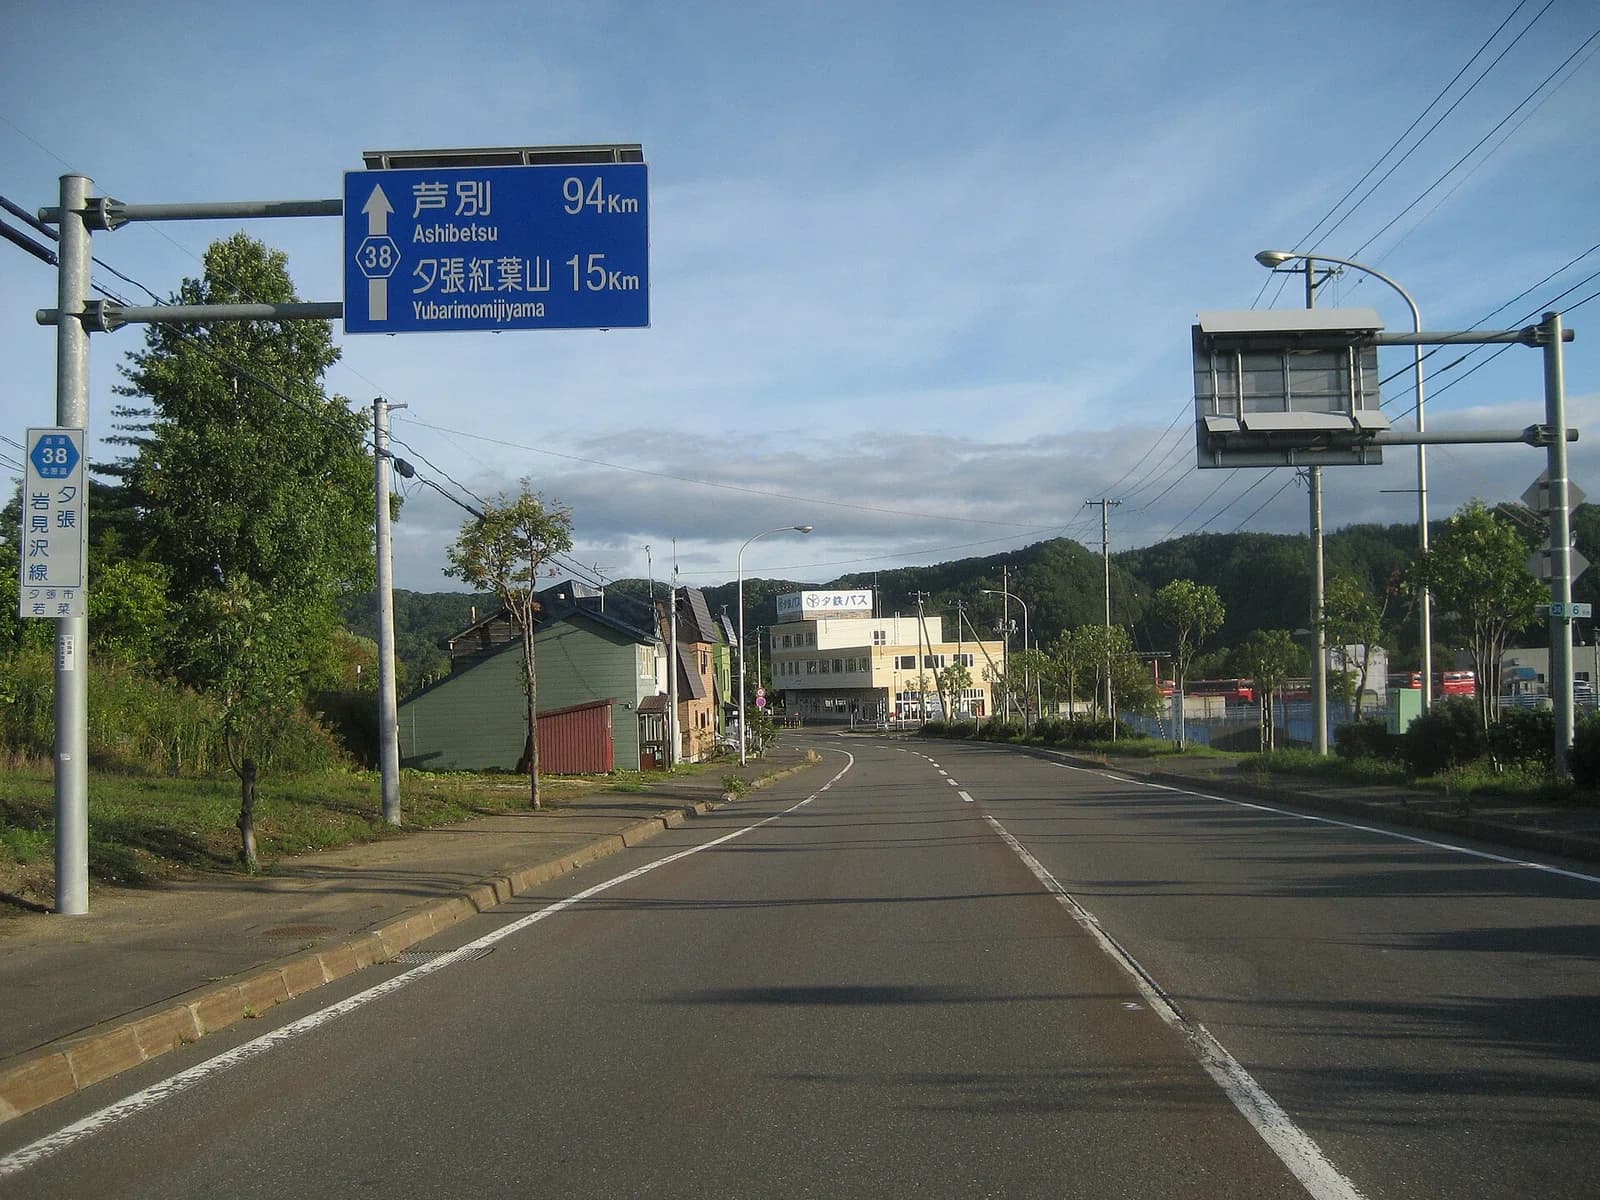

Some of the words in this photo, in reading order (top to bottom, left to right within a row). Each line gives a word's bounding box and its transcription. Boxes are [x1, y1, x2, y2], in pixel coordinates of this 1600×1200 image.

[412, 180, 491, 218] 芦別
[413, 223, 498, 243] Ashibetsu
[365, 246, 392, 268] 38
[412, 256, 550, 294] 夕張紅葉山
[413, 300, 545, 322] Yubarimomijiyama
[42, 448, 68, 464] 38
[57, 486, 77, 528] 夕張
[29, 491, 50, 581] 岩見沢線
[29, 589, 74, 600] 夕張市
[821, 594, 869, 607] 夕鉄バス
[32, 603, 71, 615] 若菜
